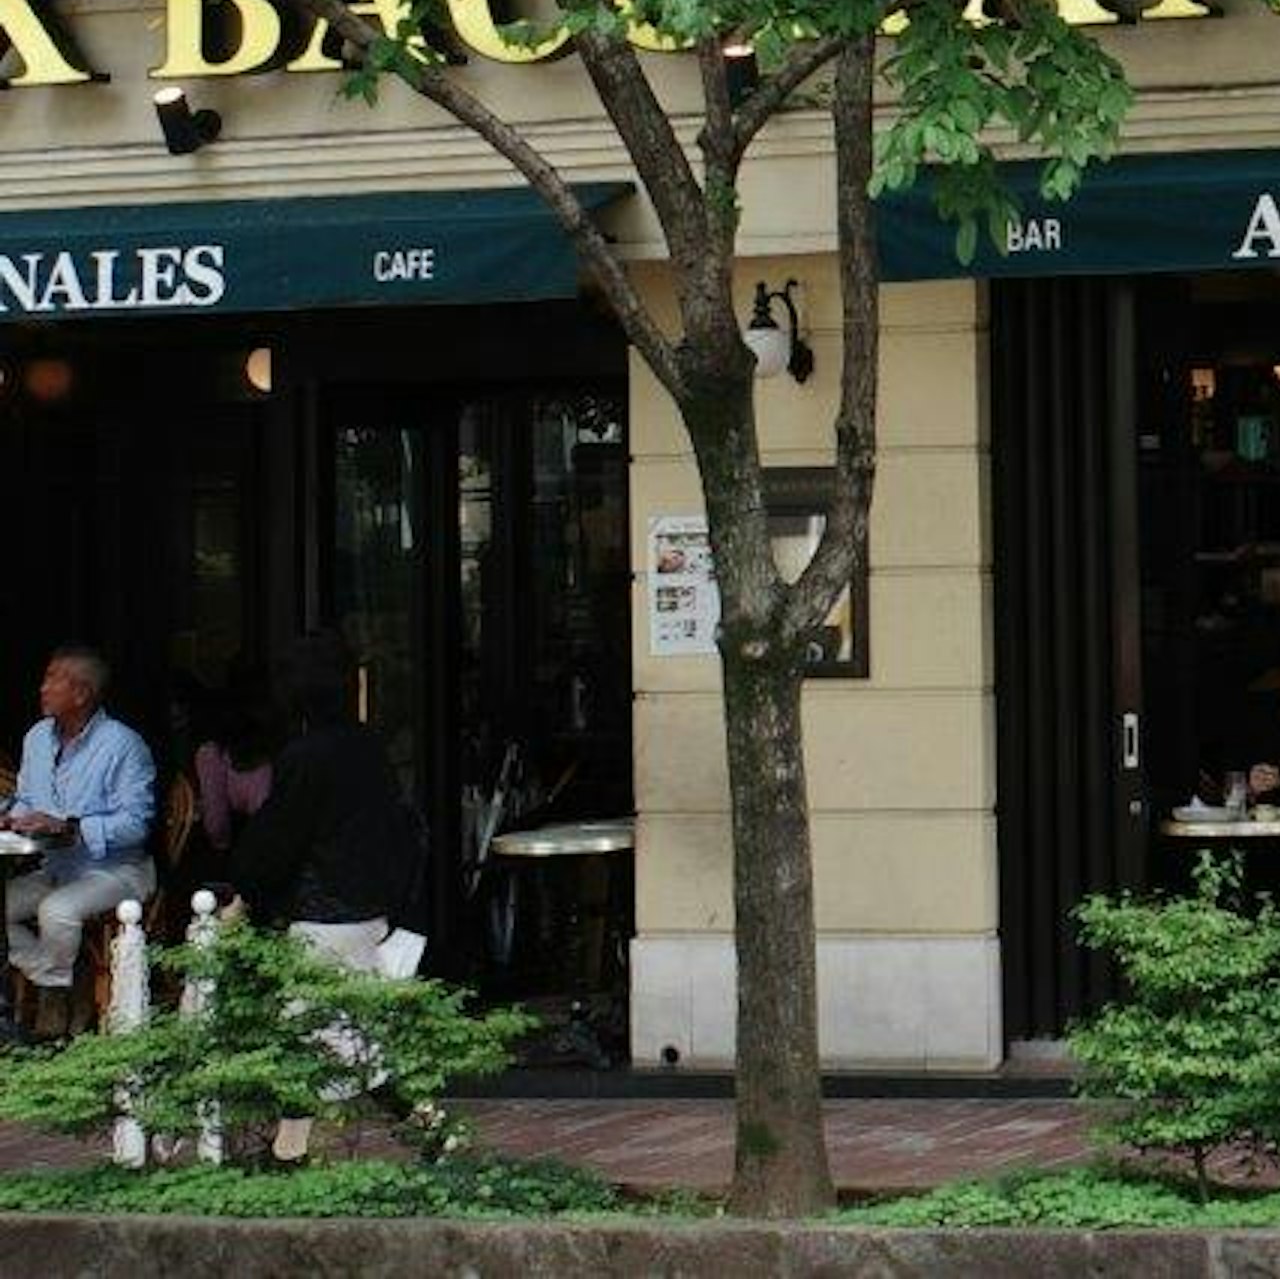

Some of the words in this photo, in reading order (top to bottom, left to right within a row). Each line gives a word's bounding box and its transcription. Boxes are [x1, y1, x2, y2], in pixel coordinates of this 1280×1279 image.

[1006, 218, 1062, 253] BAR
[0, 245, 226, 312] NALES
[373, 249, 434, 282] CAFE
